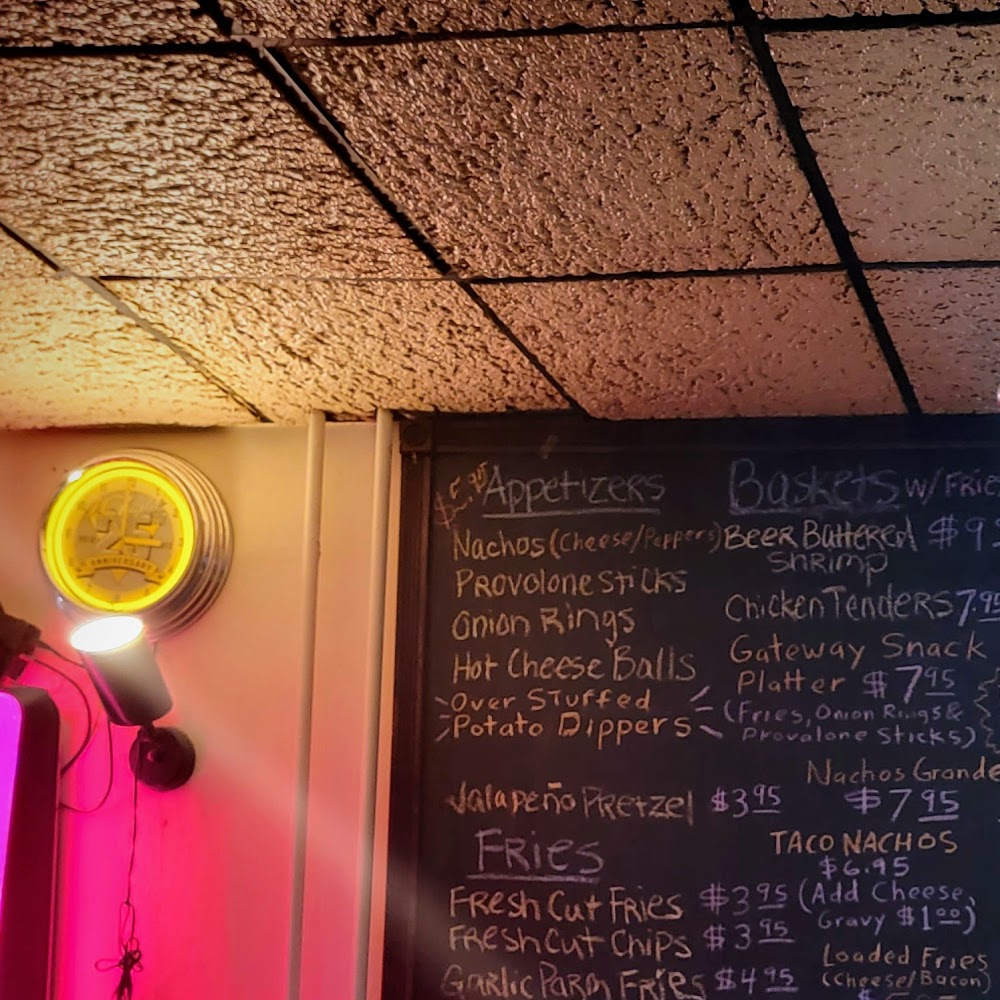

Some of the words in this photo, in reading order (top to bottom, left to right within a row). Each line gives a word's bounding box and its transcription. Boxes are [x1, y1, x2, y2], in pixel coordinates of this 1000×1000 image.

[452, 528, 545, 560] Nachos
[725, 590, 824, 623] Chicken
[452, 610, 530, 640] Onion
[540, 602, 635, 647] Rings
[453, 652, 498, 684] Hot
[508, 648, 604, 680] Cheese
[612, 646, 696, 681] Balls
[730, 633, 865, 670] Gateway
[882, 631, 987, 660] Snack
[738, 668, 846, 694] Platter
[451, 692, 516, 712] Over
[816, 705, 874, 720] Onion
[453, 711, 544, 738] Potato
[558, 712, 692, 750] Dippers
[807, 758, 905, 786] Nachos
[770, 830, 834, 856] TACO
[843, 830, 958, 857] NACHOS
[819, 856, 910, 880] $6.95
[548, 890, 604, 922] Cut
[800, 878, 859, 913] (Add
[818, 910, 885, 936] Gravy
[545, 927, 605, 960] Cut
[610, 929, 692, 962] Chips
[822, 942, 910, 968] Loaded
[922, 947, 989, 971] Fries
